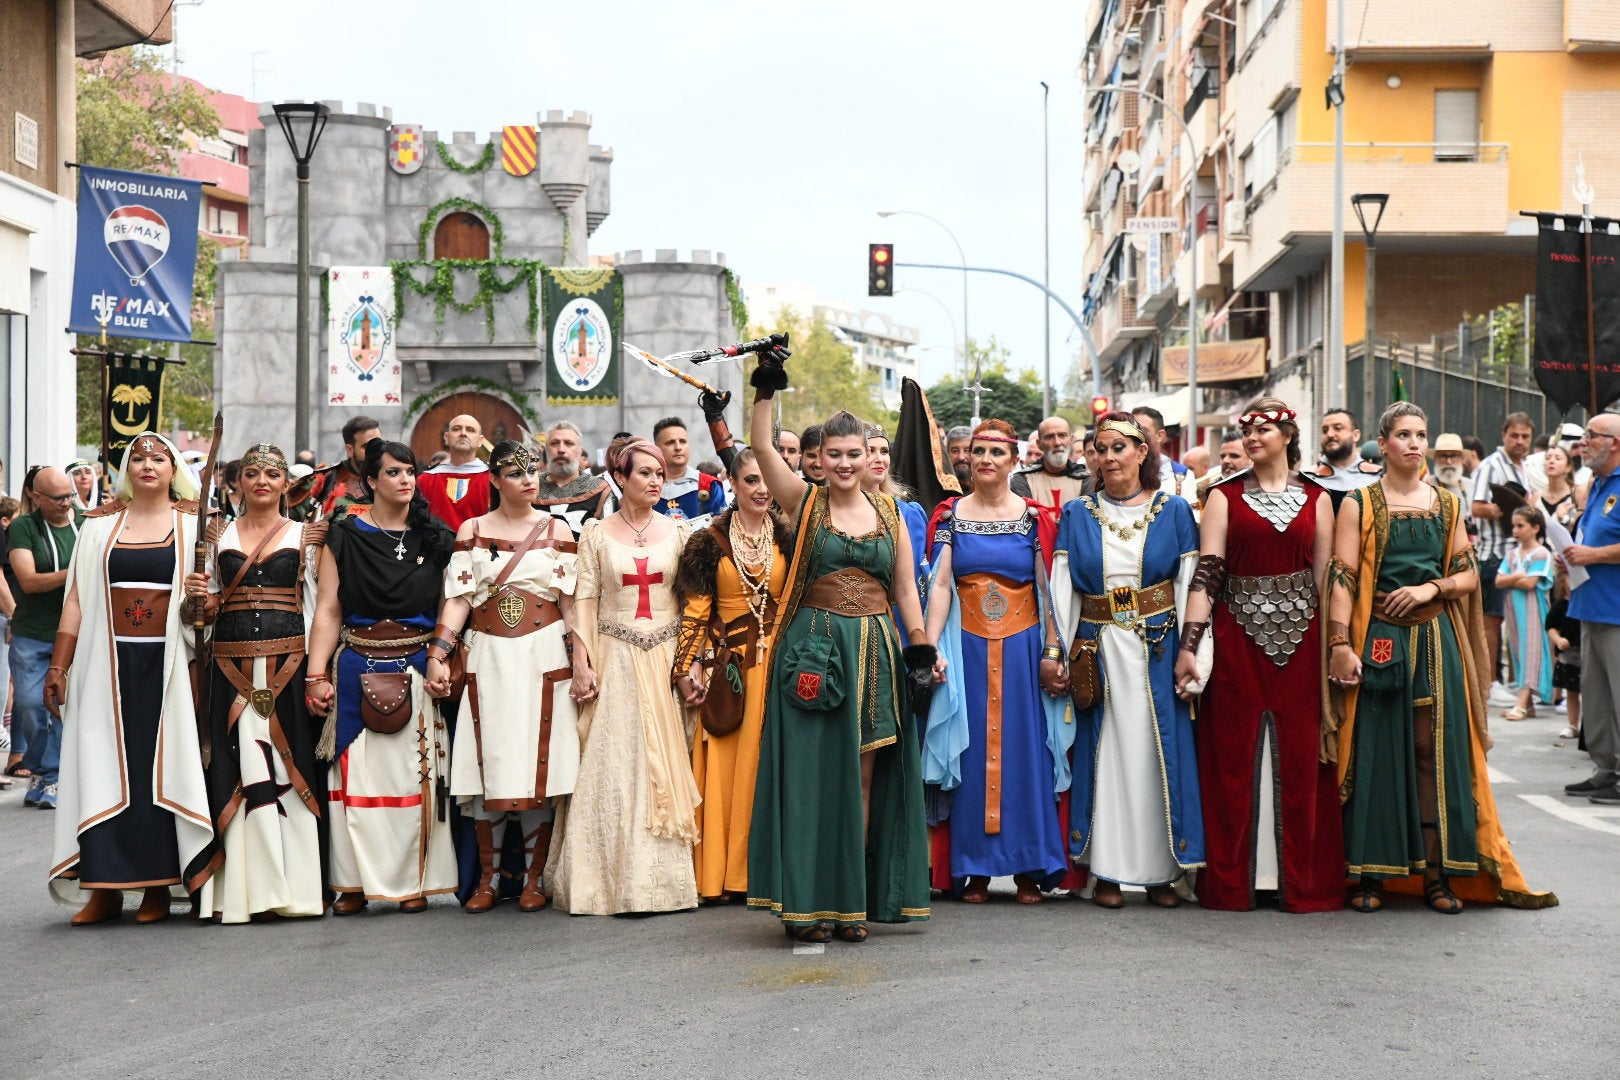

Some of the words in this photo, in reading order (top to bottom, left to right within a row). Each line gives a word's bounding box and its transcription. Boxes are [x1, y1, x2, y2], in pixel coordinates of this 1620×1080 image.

[91, 178, 188, 201] INMOBILIARIA
[113, 224, 162, 241] RE/MAX
[1129, 221, 1178, 229] PENSION
[91, 294, 171, 318] RE/MAX
[115, 316, 148, 328] BLUE
